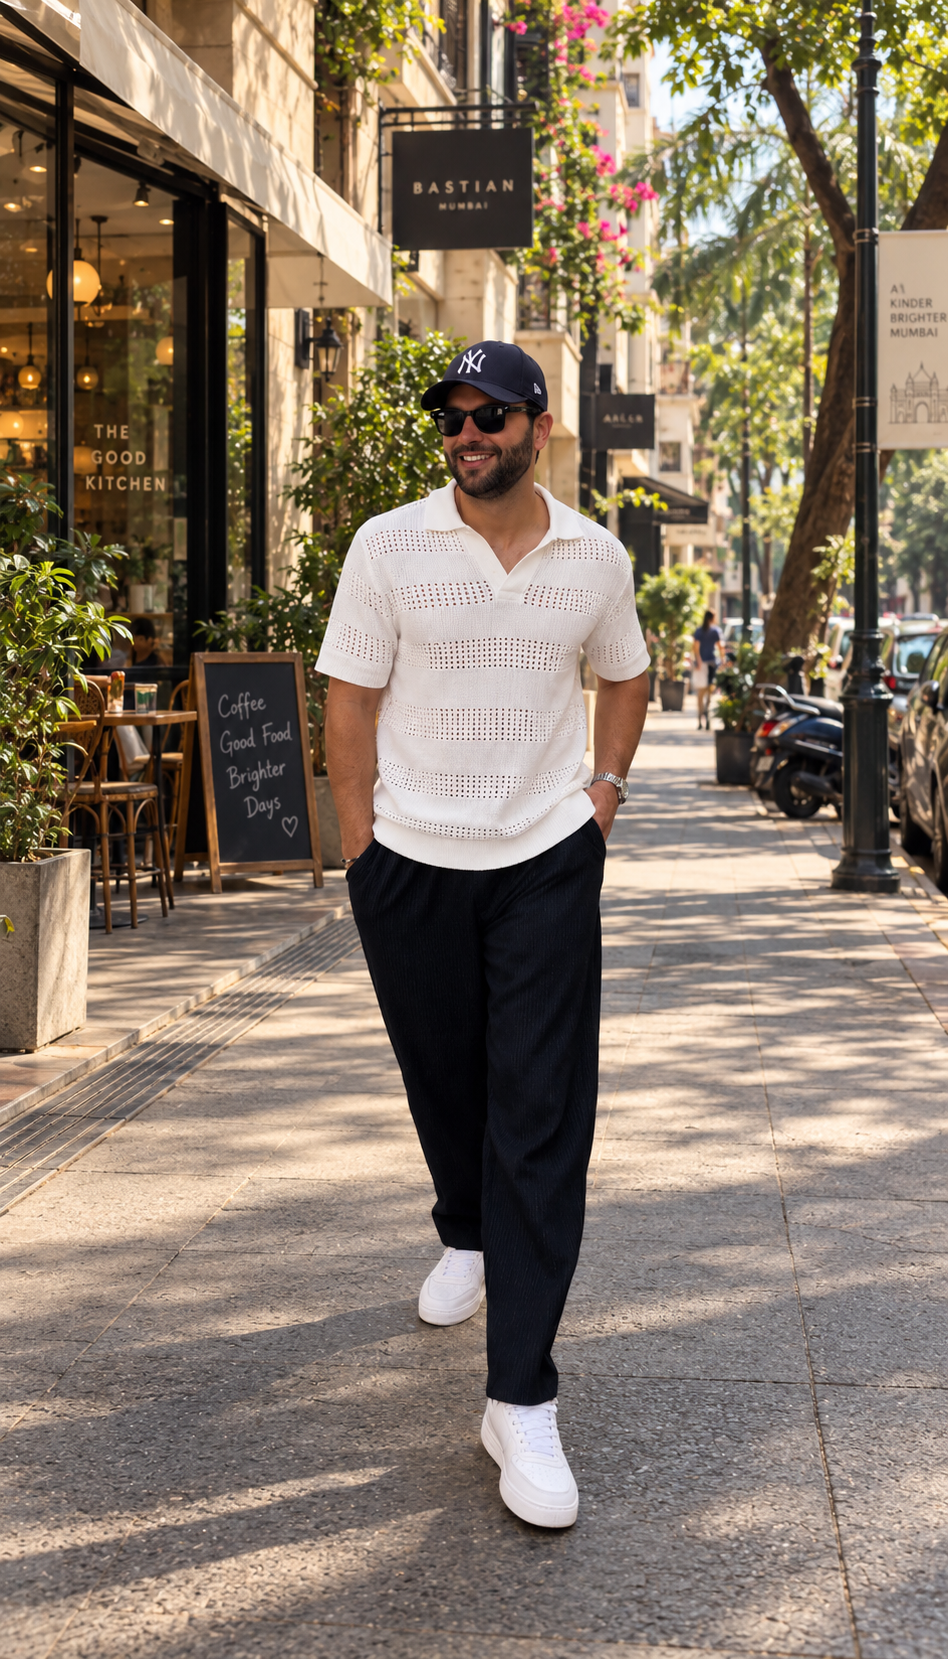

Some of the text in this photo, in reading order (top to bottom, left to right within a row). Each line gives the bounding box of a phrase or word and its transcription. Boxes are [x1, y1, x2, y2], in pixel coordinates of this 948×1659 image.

[413, 179, 514, 195] BASTIAN
[438, 202, 488, 211] MUMBAI
[890, 298, 933, 309] KINDER
[890, 312, 947, 324] BRIGHTER
[890, 327, 938, 338] MUMBAI
[93, 423, 130, 440] THE
[91, 450, 147, 466] GOOD
[85, 475, 167, 492] KITCHEN
[218, 691, 267, 721] Coffee
[220, 721, 293, 758] Good Food
[226, 759, 287, 793] Brighter
[243, 795, 282, 821] Days
